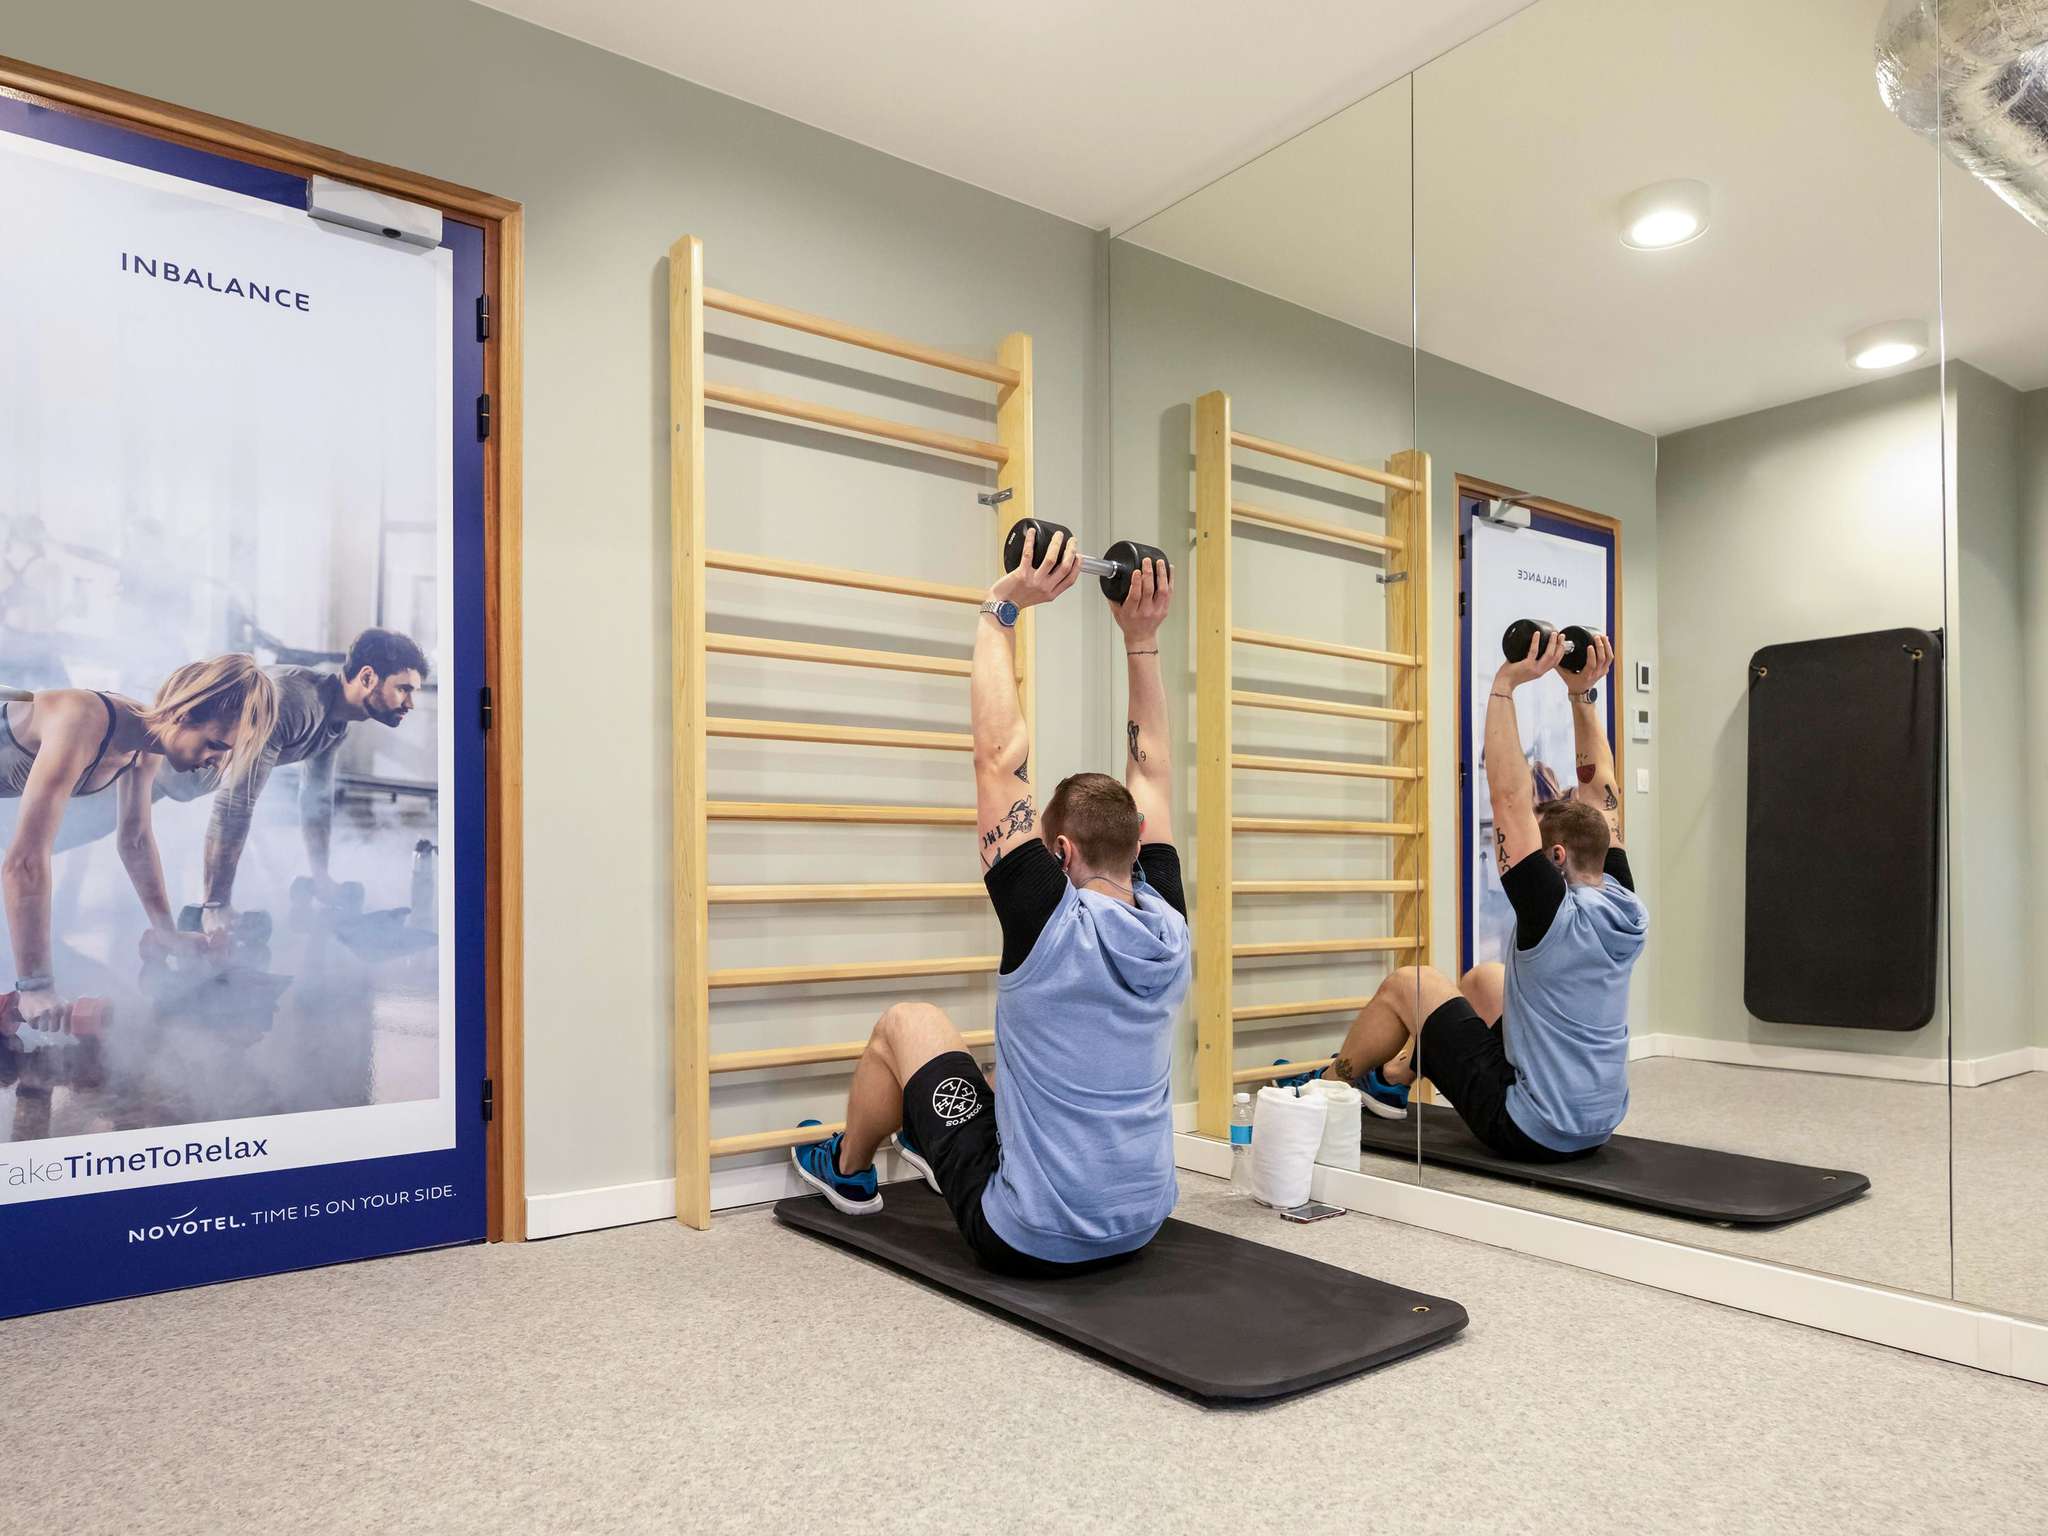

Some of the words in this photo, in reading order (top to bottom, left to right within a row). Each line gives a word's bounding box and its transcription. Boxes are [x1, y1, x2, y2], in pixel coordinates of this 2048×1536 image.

[121, 252, 310, 312] INBALANCE
[251, 1206, 298, 1225] TIME
[304, 1203, 320, 1218] IS
[326, 1199, 355, 1214] ON
[360, 1192, 410, 1210] YOUR
[415, 1184, 457, 1203] SIDE.
